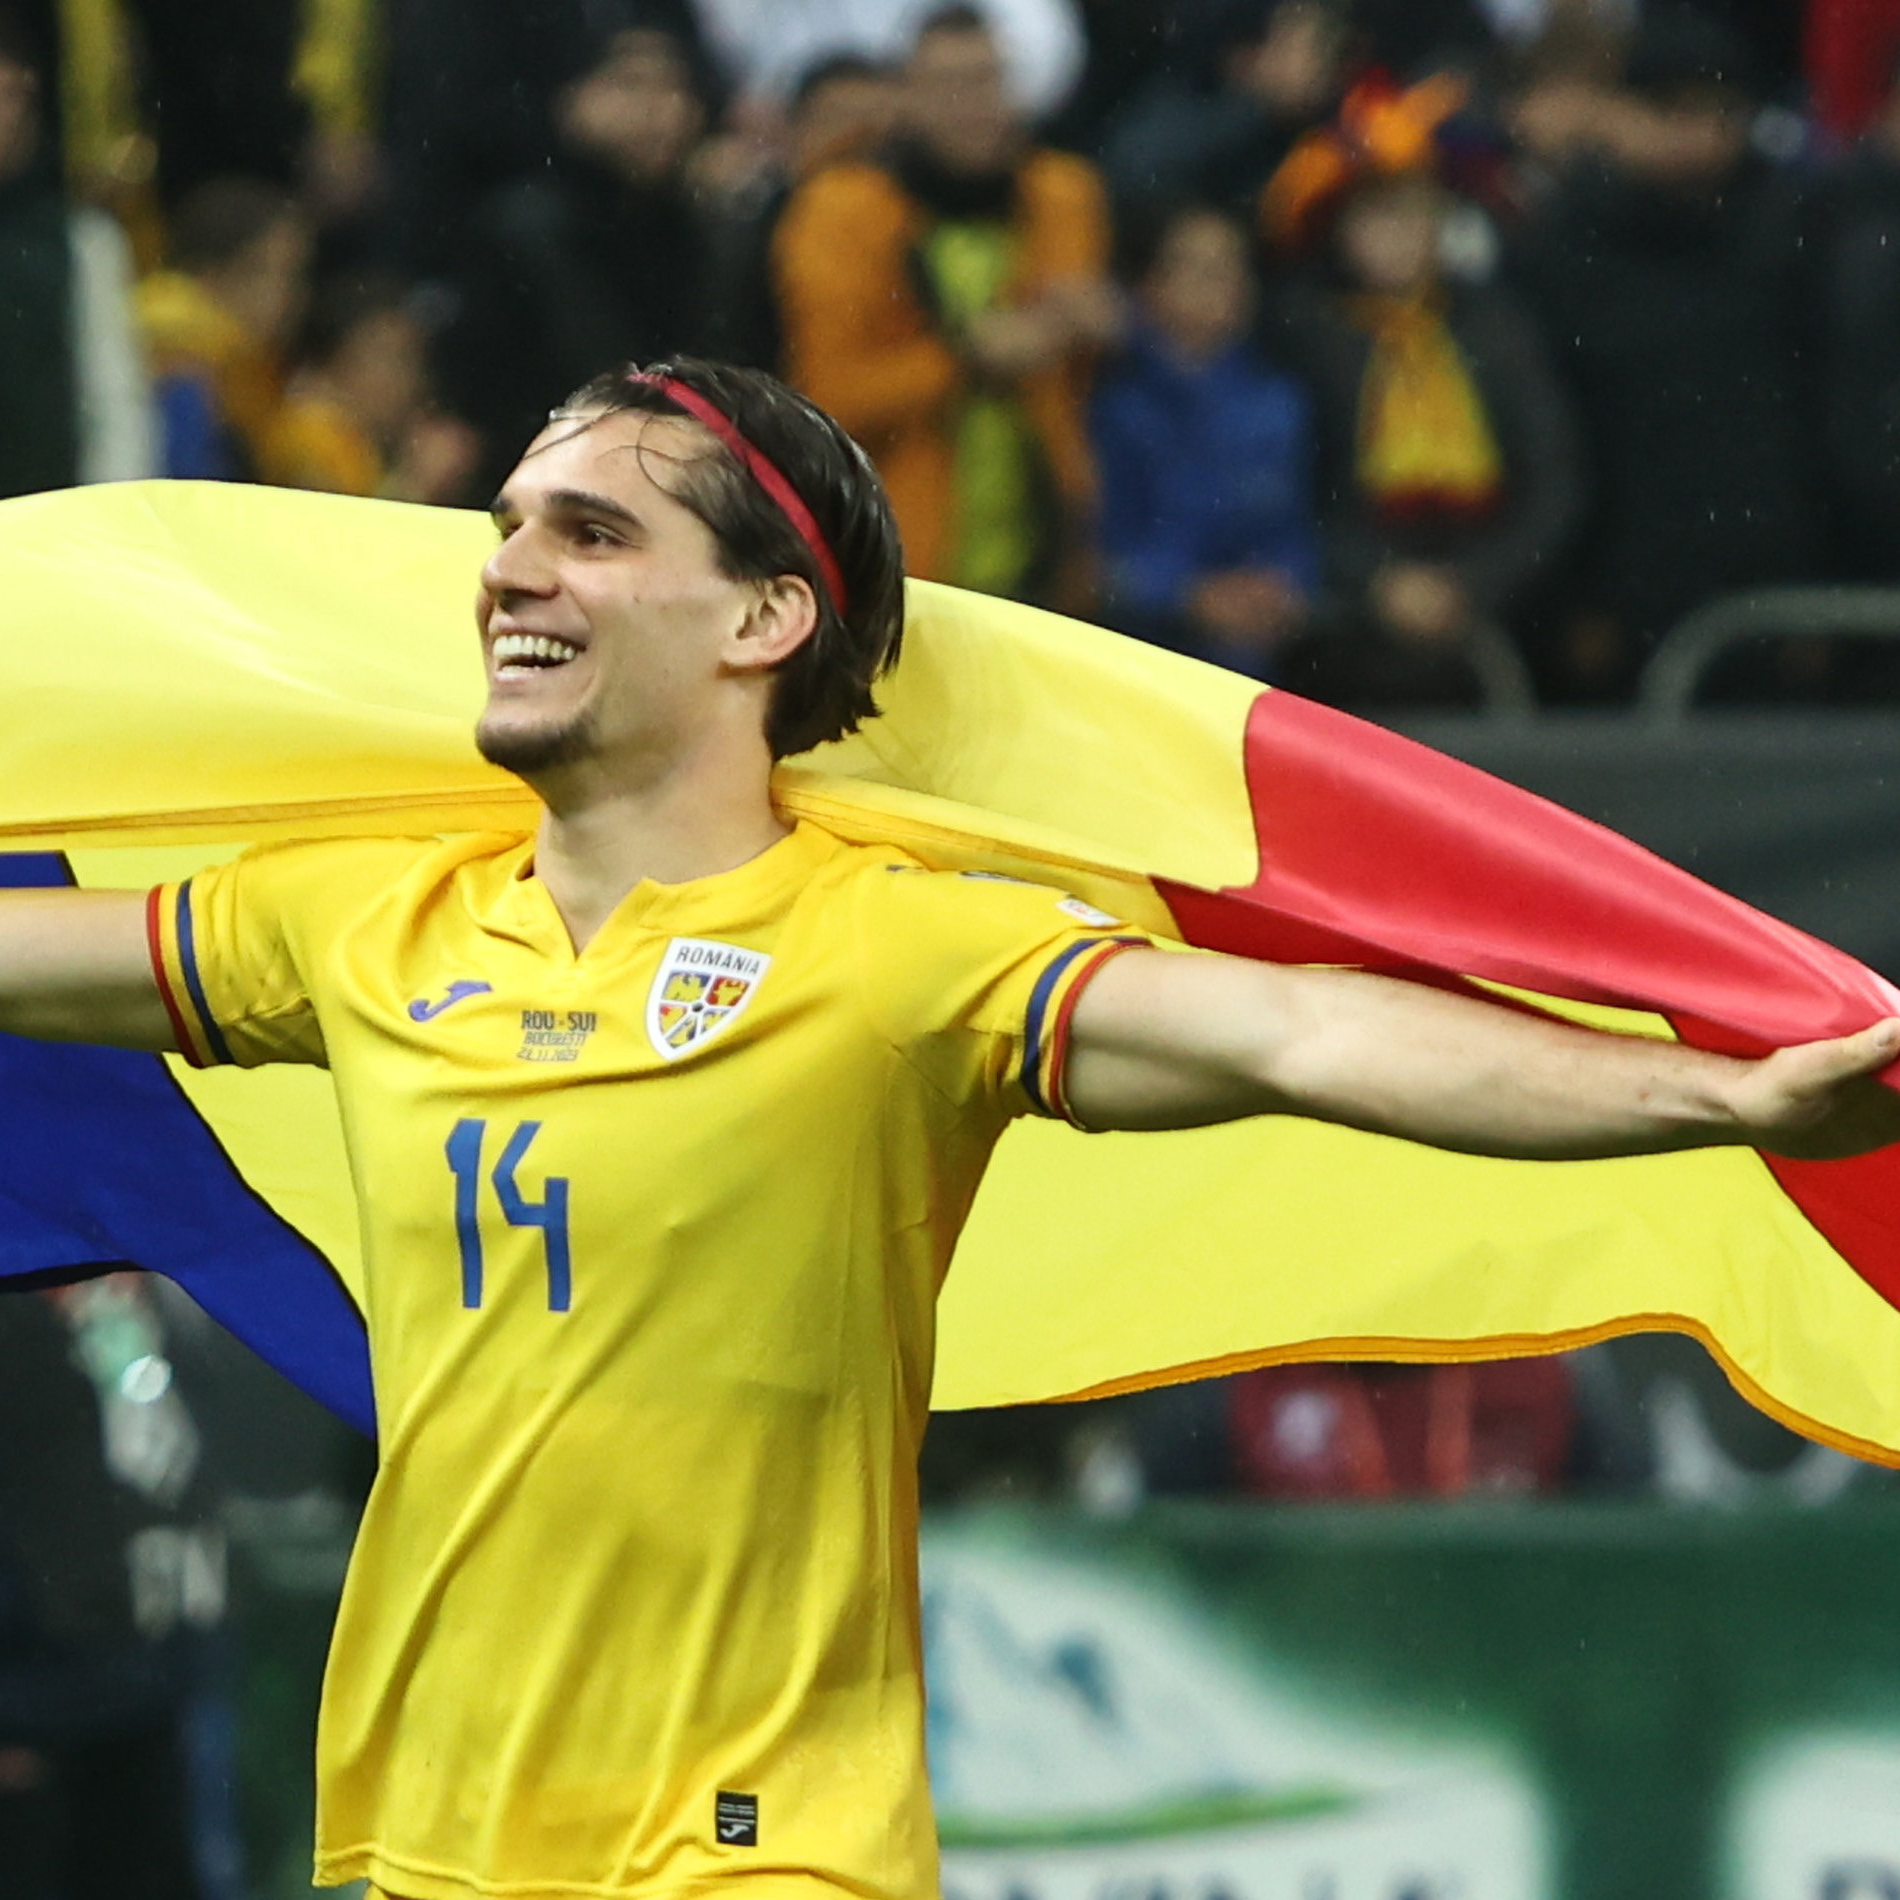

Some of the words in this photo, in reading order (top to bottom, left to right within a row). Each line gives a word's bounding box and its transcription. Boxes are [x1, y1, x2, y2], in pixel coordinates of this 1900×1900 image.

[521, 1010, 555, 1030] ROU
[567, 1011, 597, 1032] SUI
[445, 1118, 572, 1312] 14
